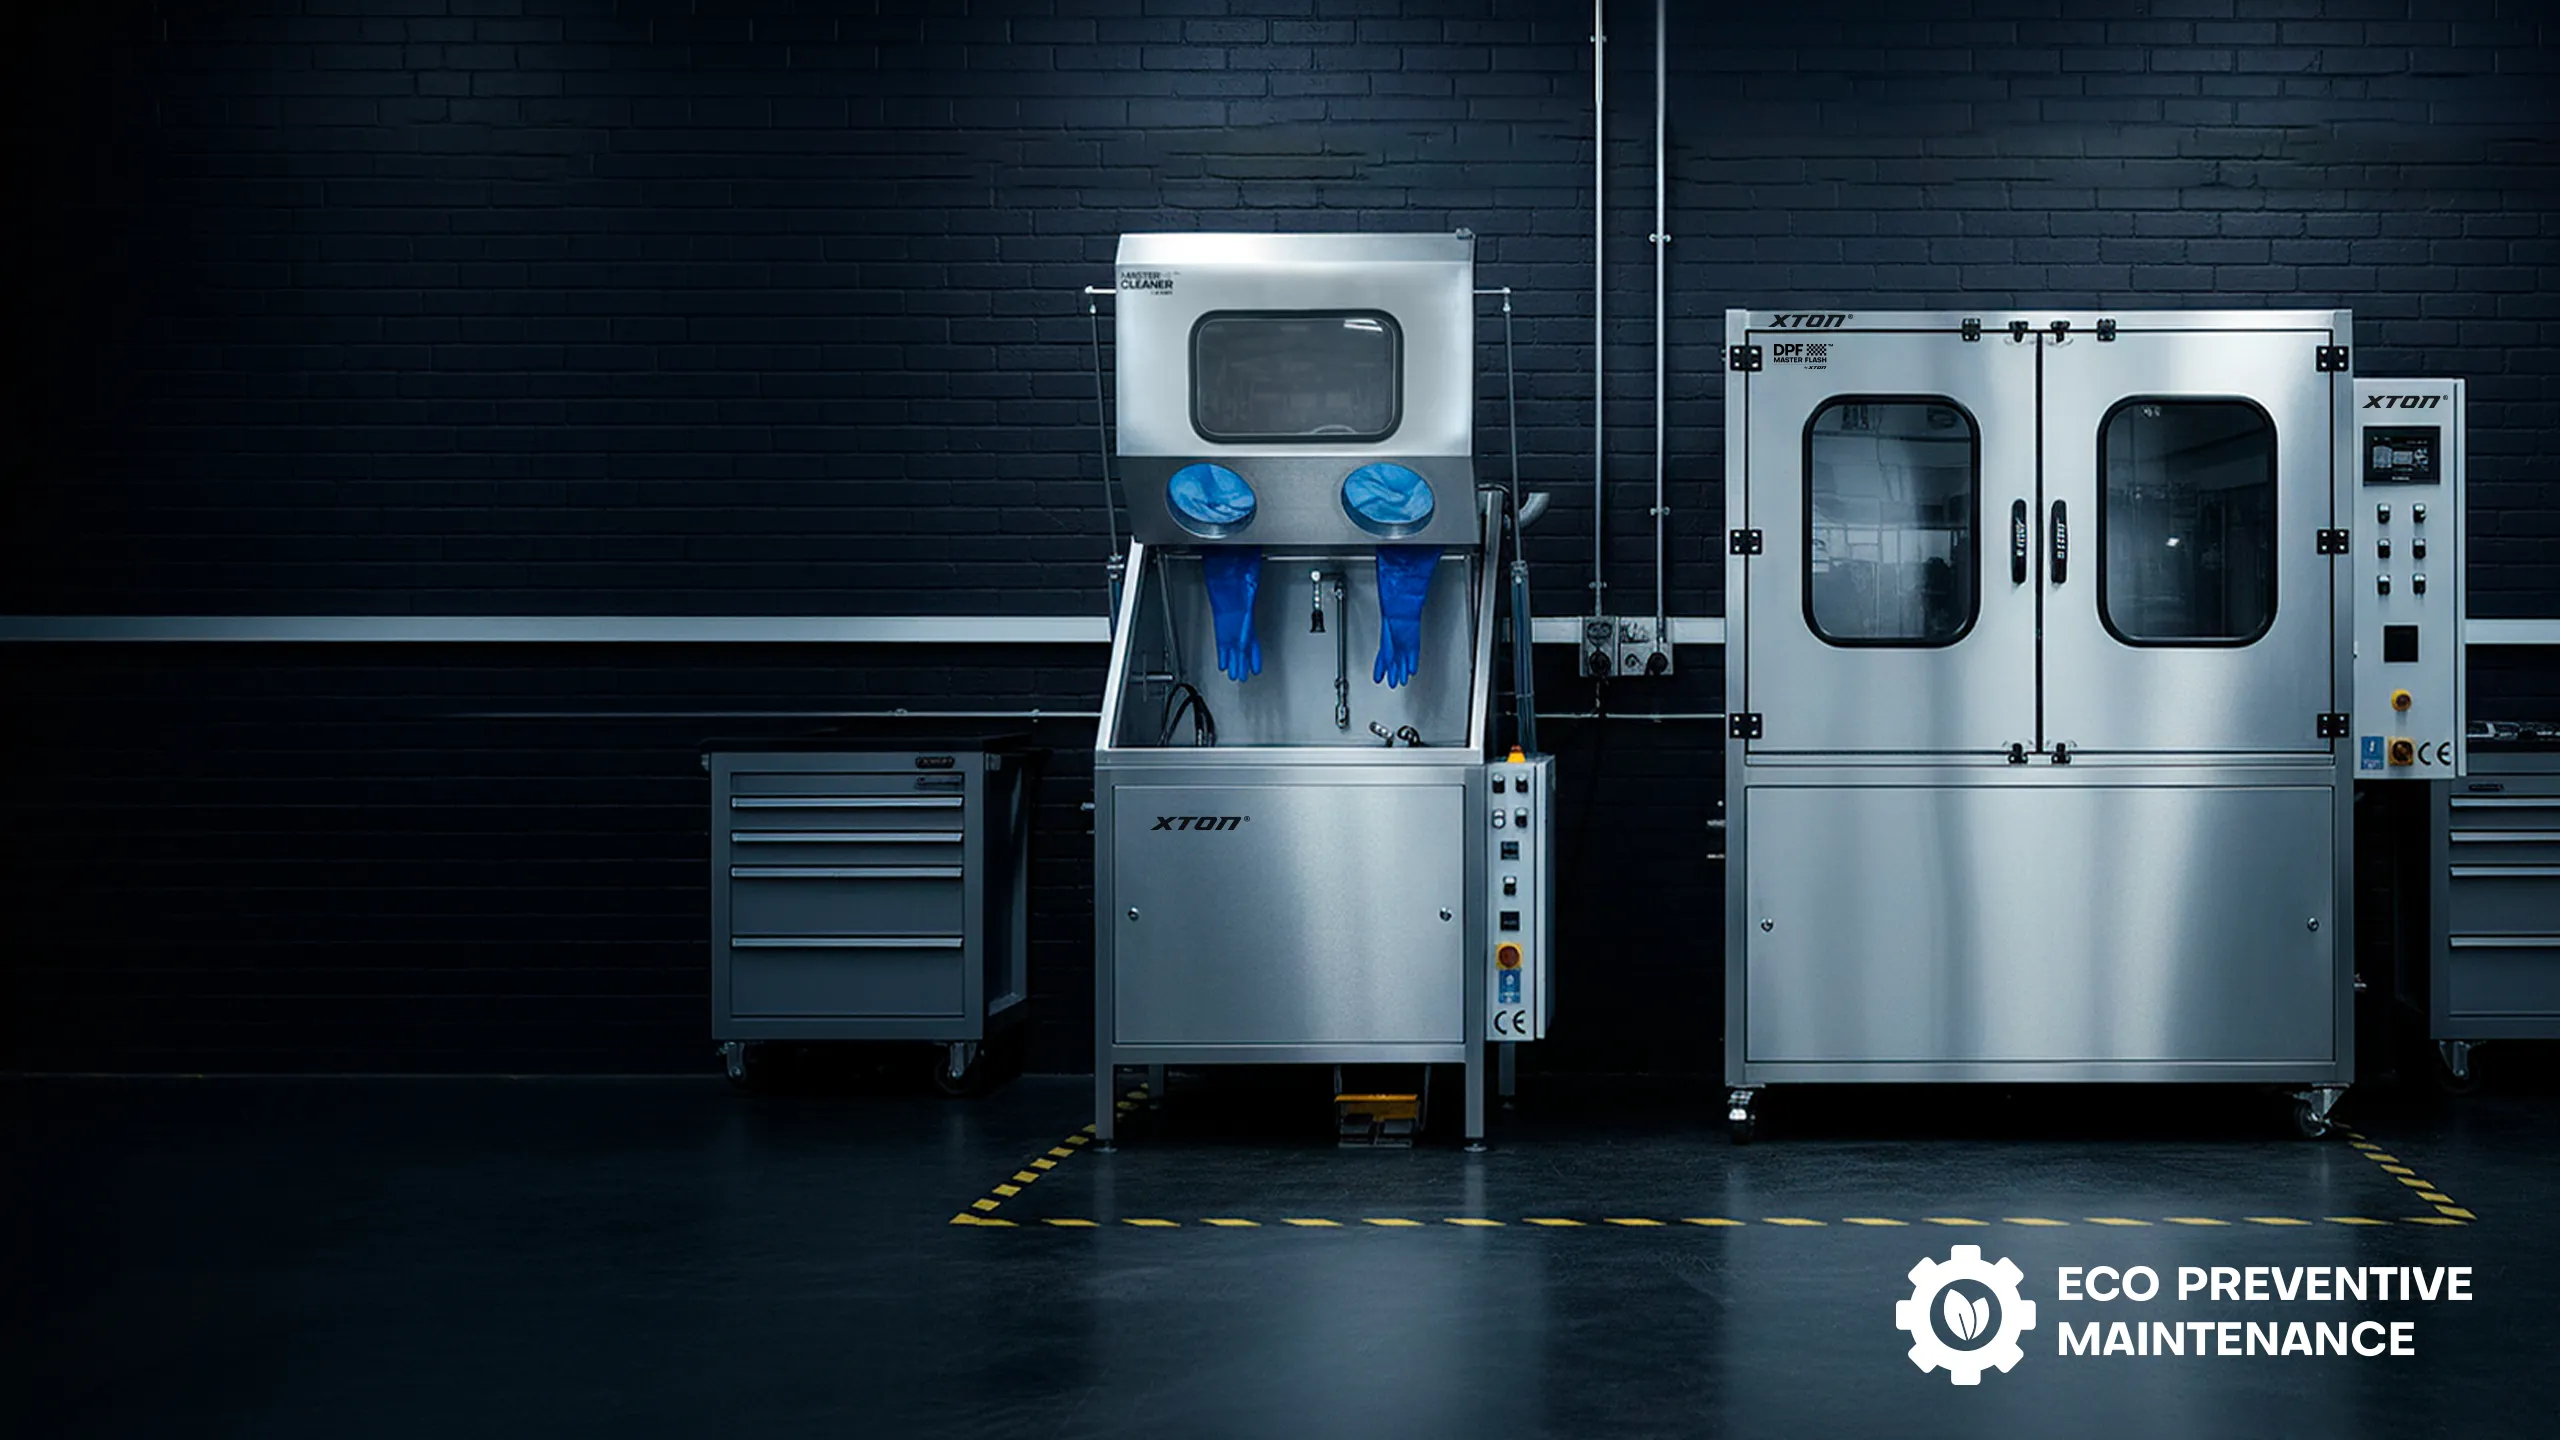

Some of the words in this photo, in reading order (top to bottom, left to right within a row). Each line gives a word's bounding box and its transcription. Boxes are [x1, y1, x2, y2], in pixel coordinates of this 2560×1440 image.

[1120, 279, 1174, 290] CLEANER
[1773, 343, 1804, 357] DPF
[1773, 356, 1803, 364] MASTER
[1804, 356, 1828, 364] FLASH
